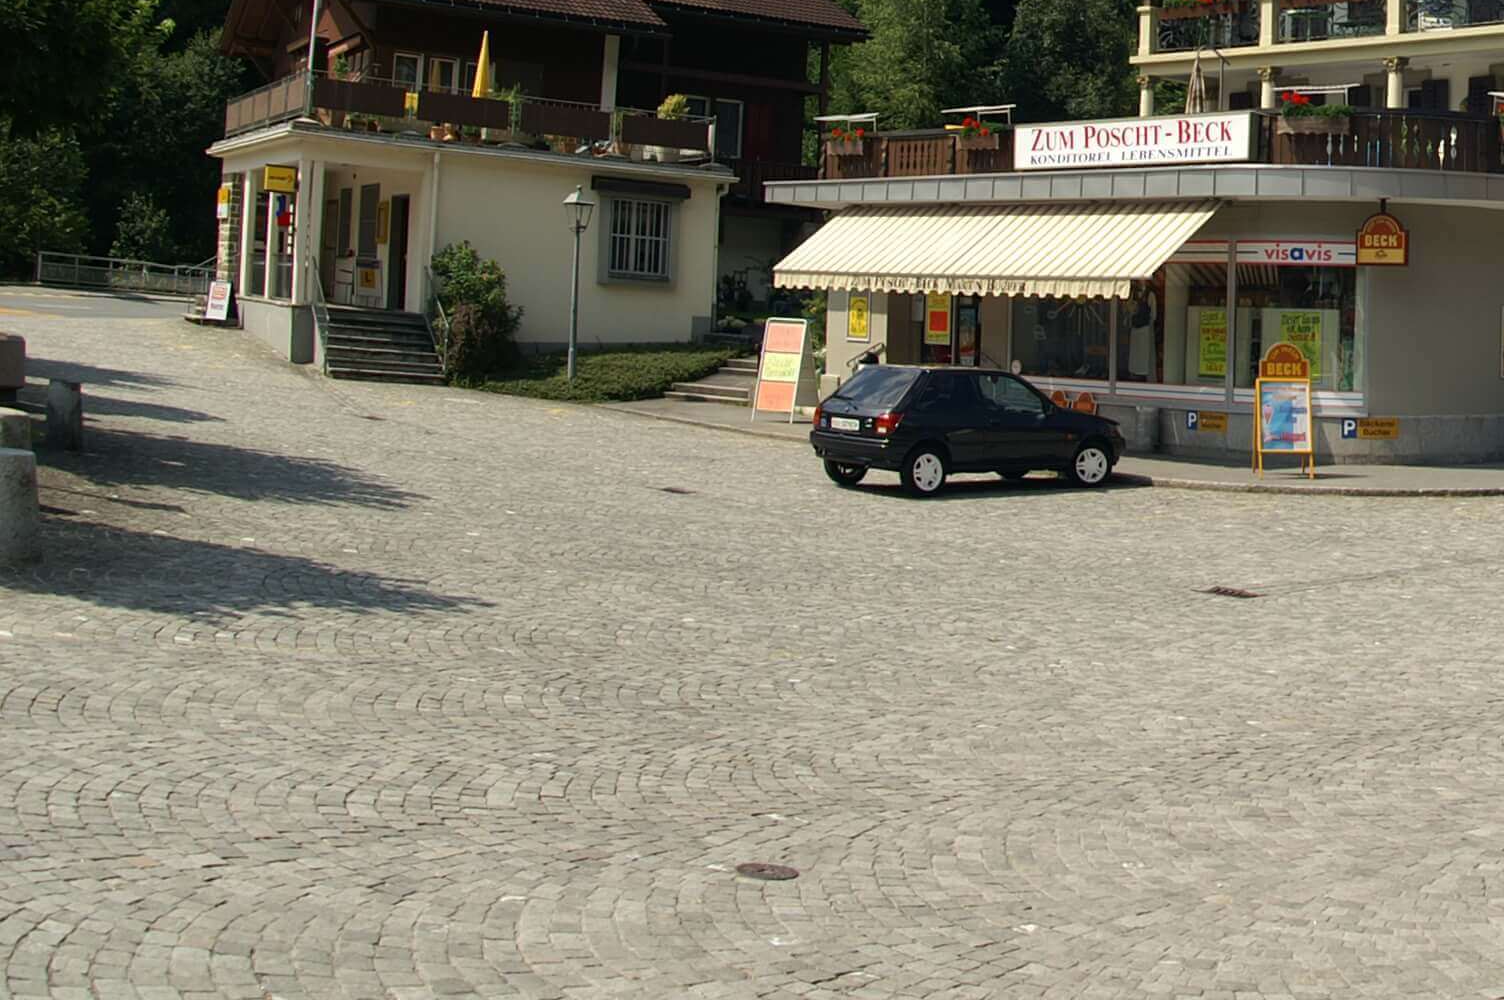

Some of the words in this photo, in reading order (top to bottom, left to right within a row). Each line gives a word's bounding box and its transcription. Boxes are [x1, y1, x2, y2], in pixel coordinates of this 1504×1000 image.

[1031, 127, 1075, 151] ZUM
[1364, 233, 1398, 247] BECK
[1264, 243, 1333, 262] visavis
[1266, 361, 1303, 376] BECK
[1188, 411, 1197, 428] P
[1343, 419, 1356, 436] P
